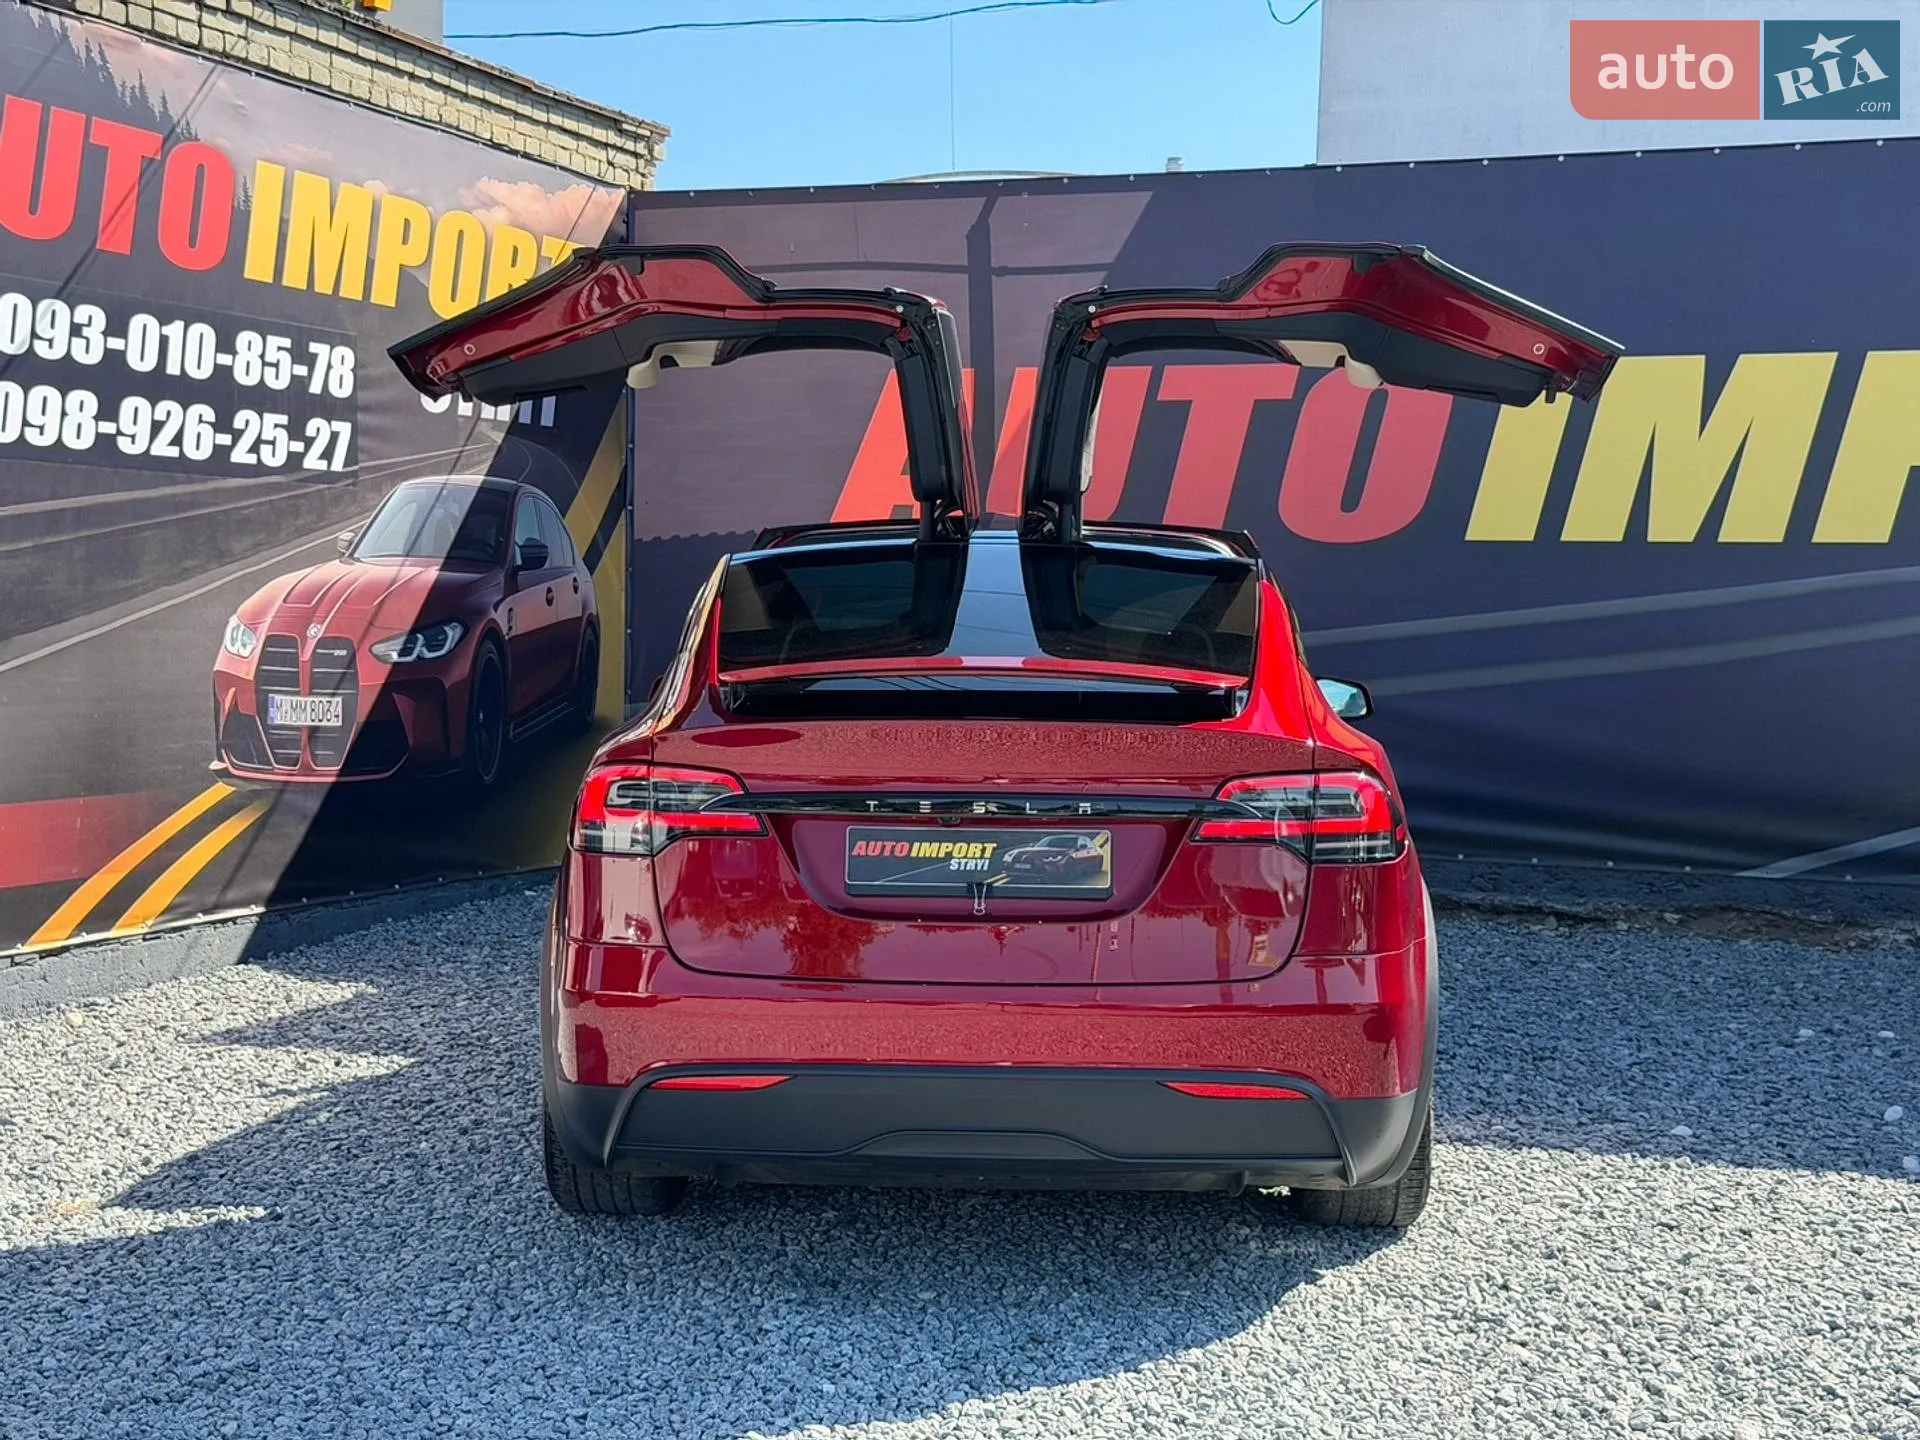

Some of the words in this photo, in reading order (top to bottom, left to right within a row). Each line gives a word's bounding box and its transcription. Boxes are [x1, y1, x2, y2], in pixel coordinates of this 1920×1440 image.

[0, 292, 355, 399] 093-010-85-78
[0, 380, 352, 473] 098-926-25-27
[865, 801, 1092, 814] TESLA
[851, 840, 910, 858] AUTO
[910, 841, 997, 859] IMPORT
